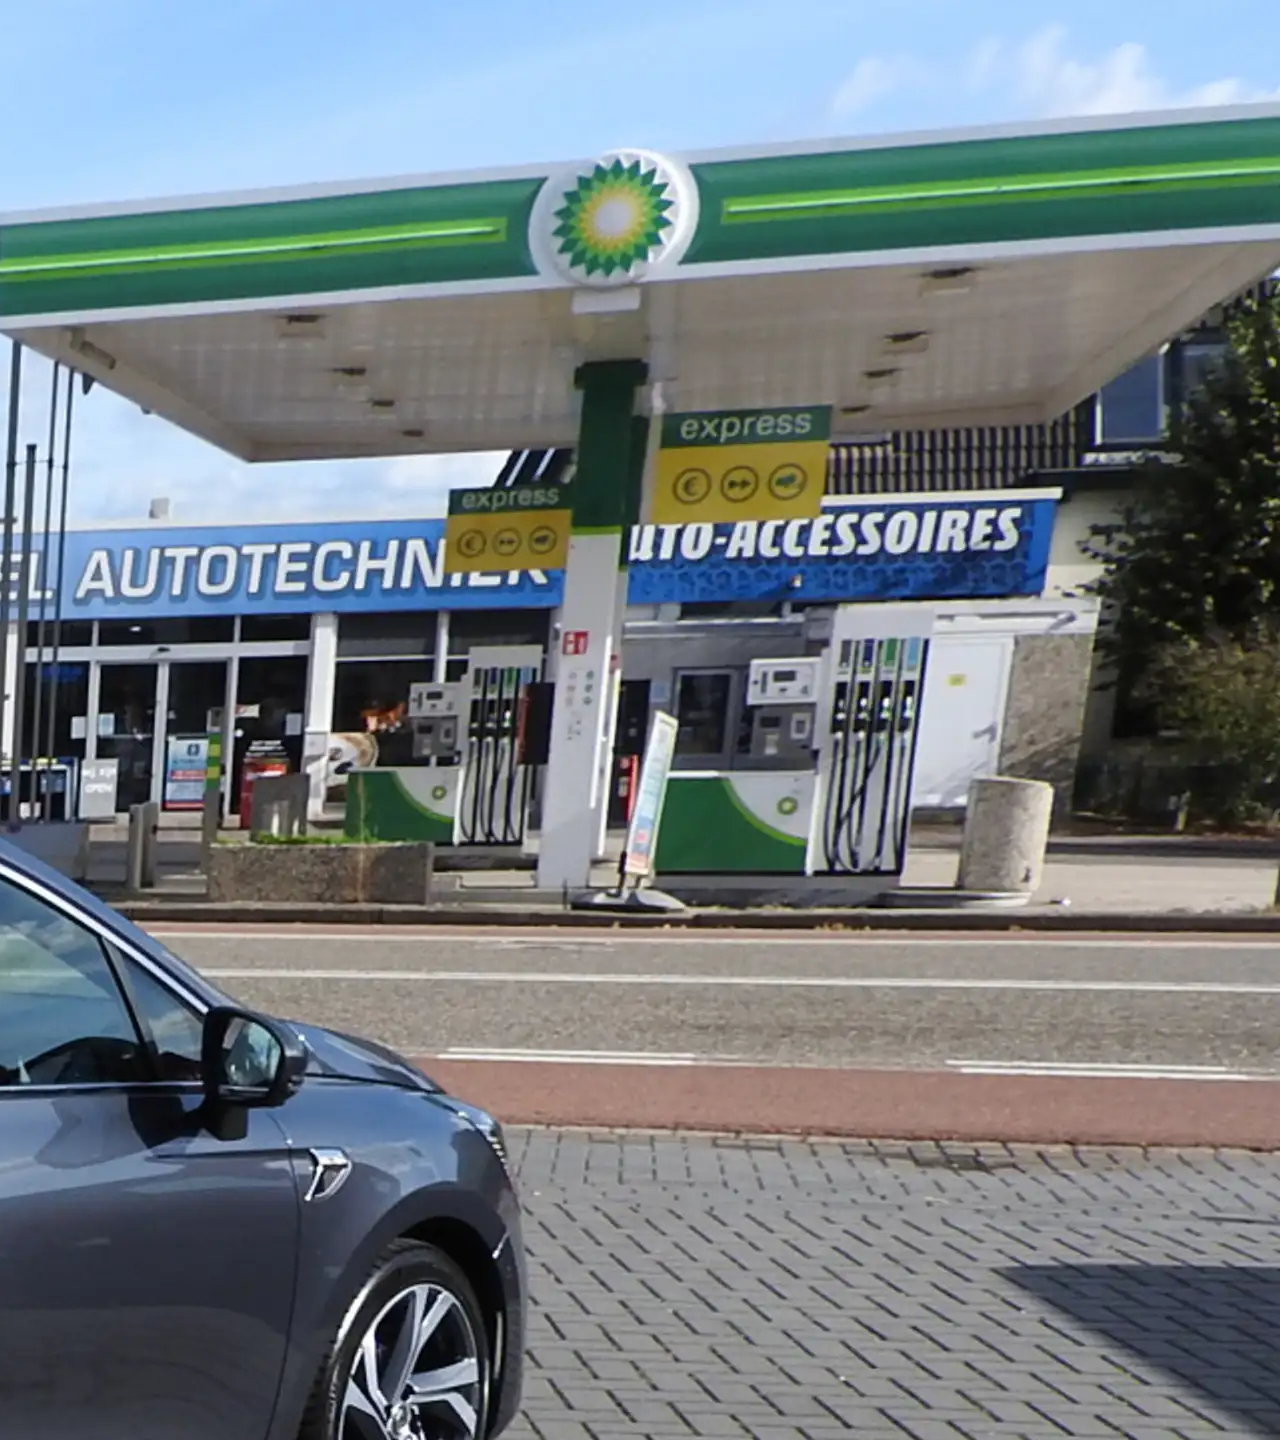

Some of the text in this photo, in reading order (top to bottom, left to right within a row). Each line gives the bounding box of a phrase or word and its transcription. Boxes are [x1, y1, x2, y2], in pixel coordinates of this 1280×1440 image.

[679, 411, 813, 443] express
[461, 486, 560, 513] express
[628, 507, 1022, 562] UTO-ACCESSOIRES
[75, 537, 548, 600] AUTOTECHN
